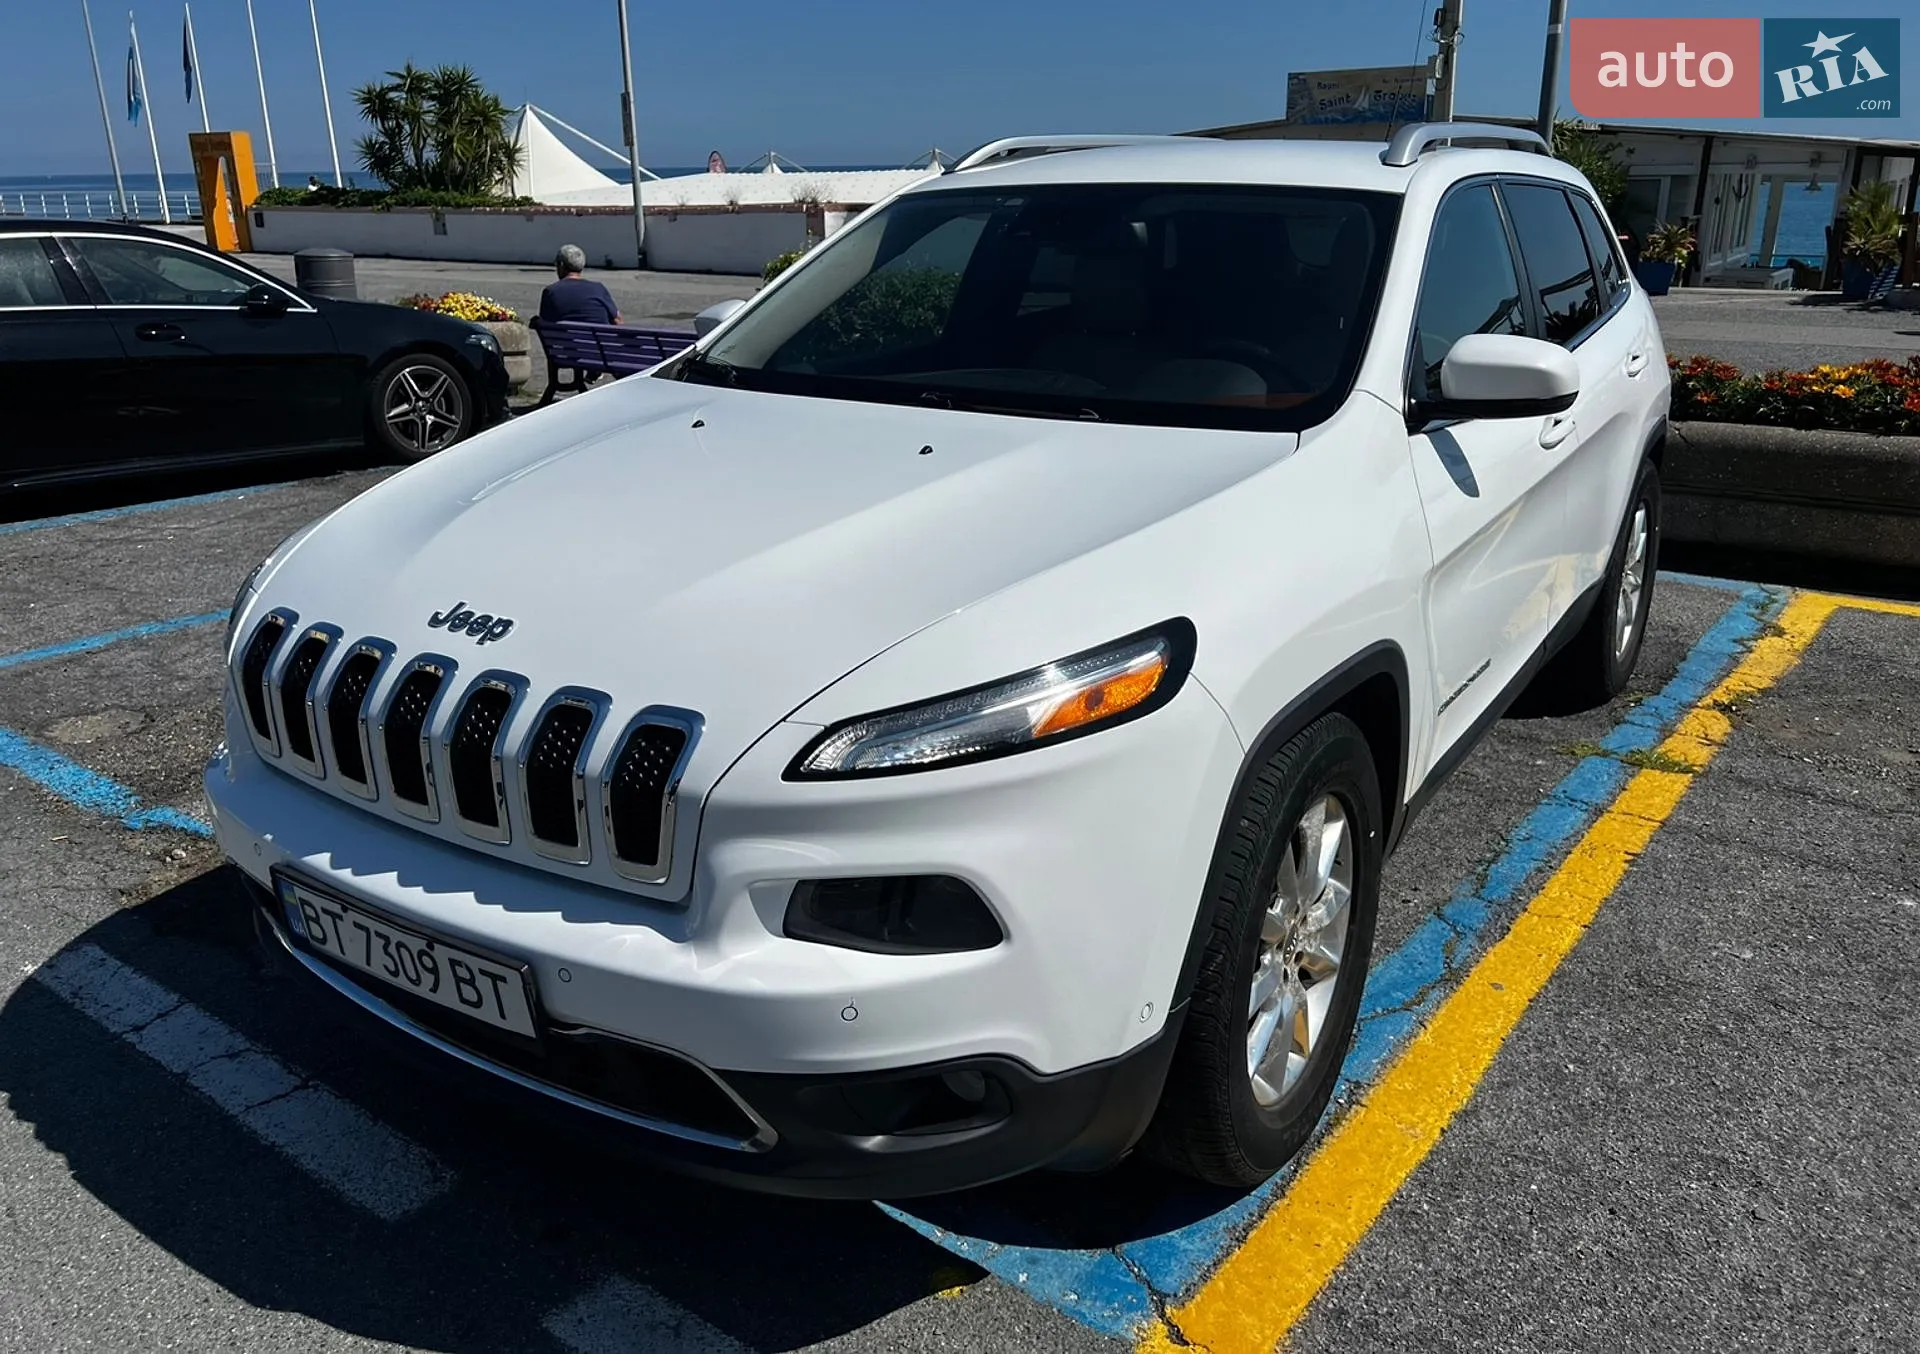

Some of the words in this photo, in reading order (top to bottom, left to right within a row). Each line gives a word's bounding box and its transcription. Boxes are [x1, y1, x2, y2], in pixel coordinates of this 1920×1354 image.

[1320, 93, 1351, 110] Saint
[427, 601, 516, 646] Jeep
[299, 897, 344, 956] BT
[353, 923, 441, 993] 7309
[448, 957, 507, 1020] BT
